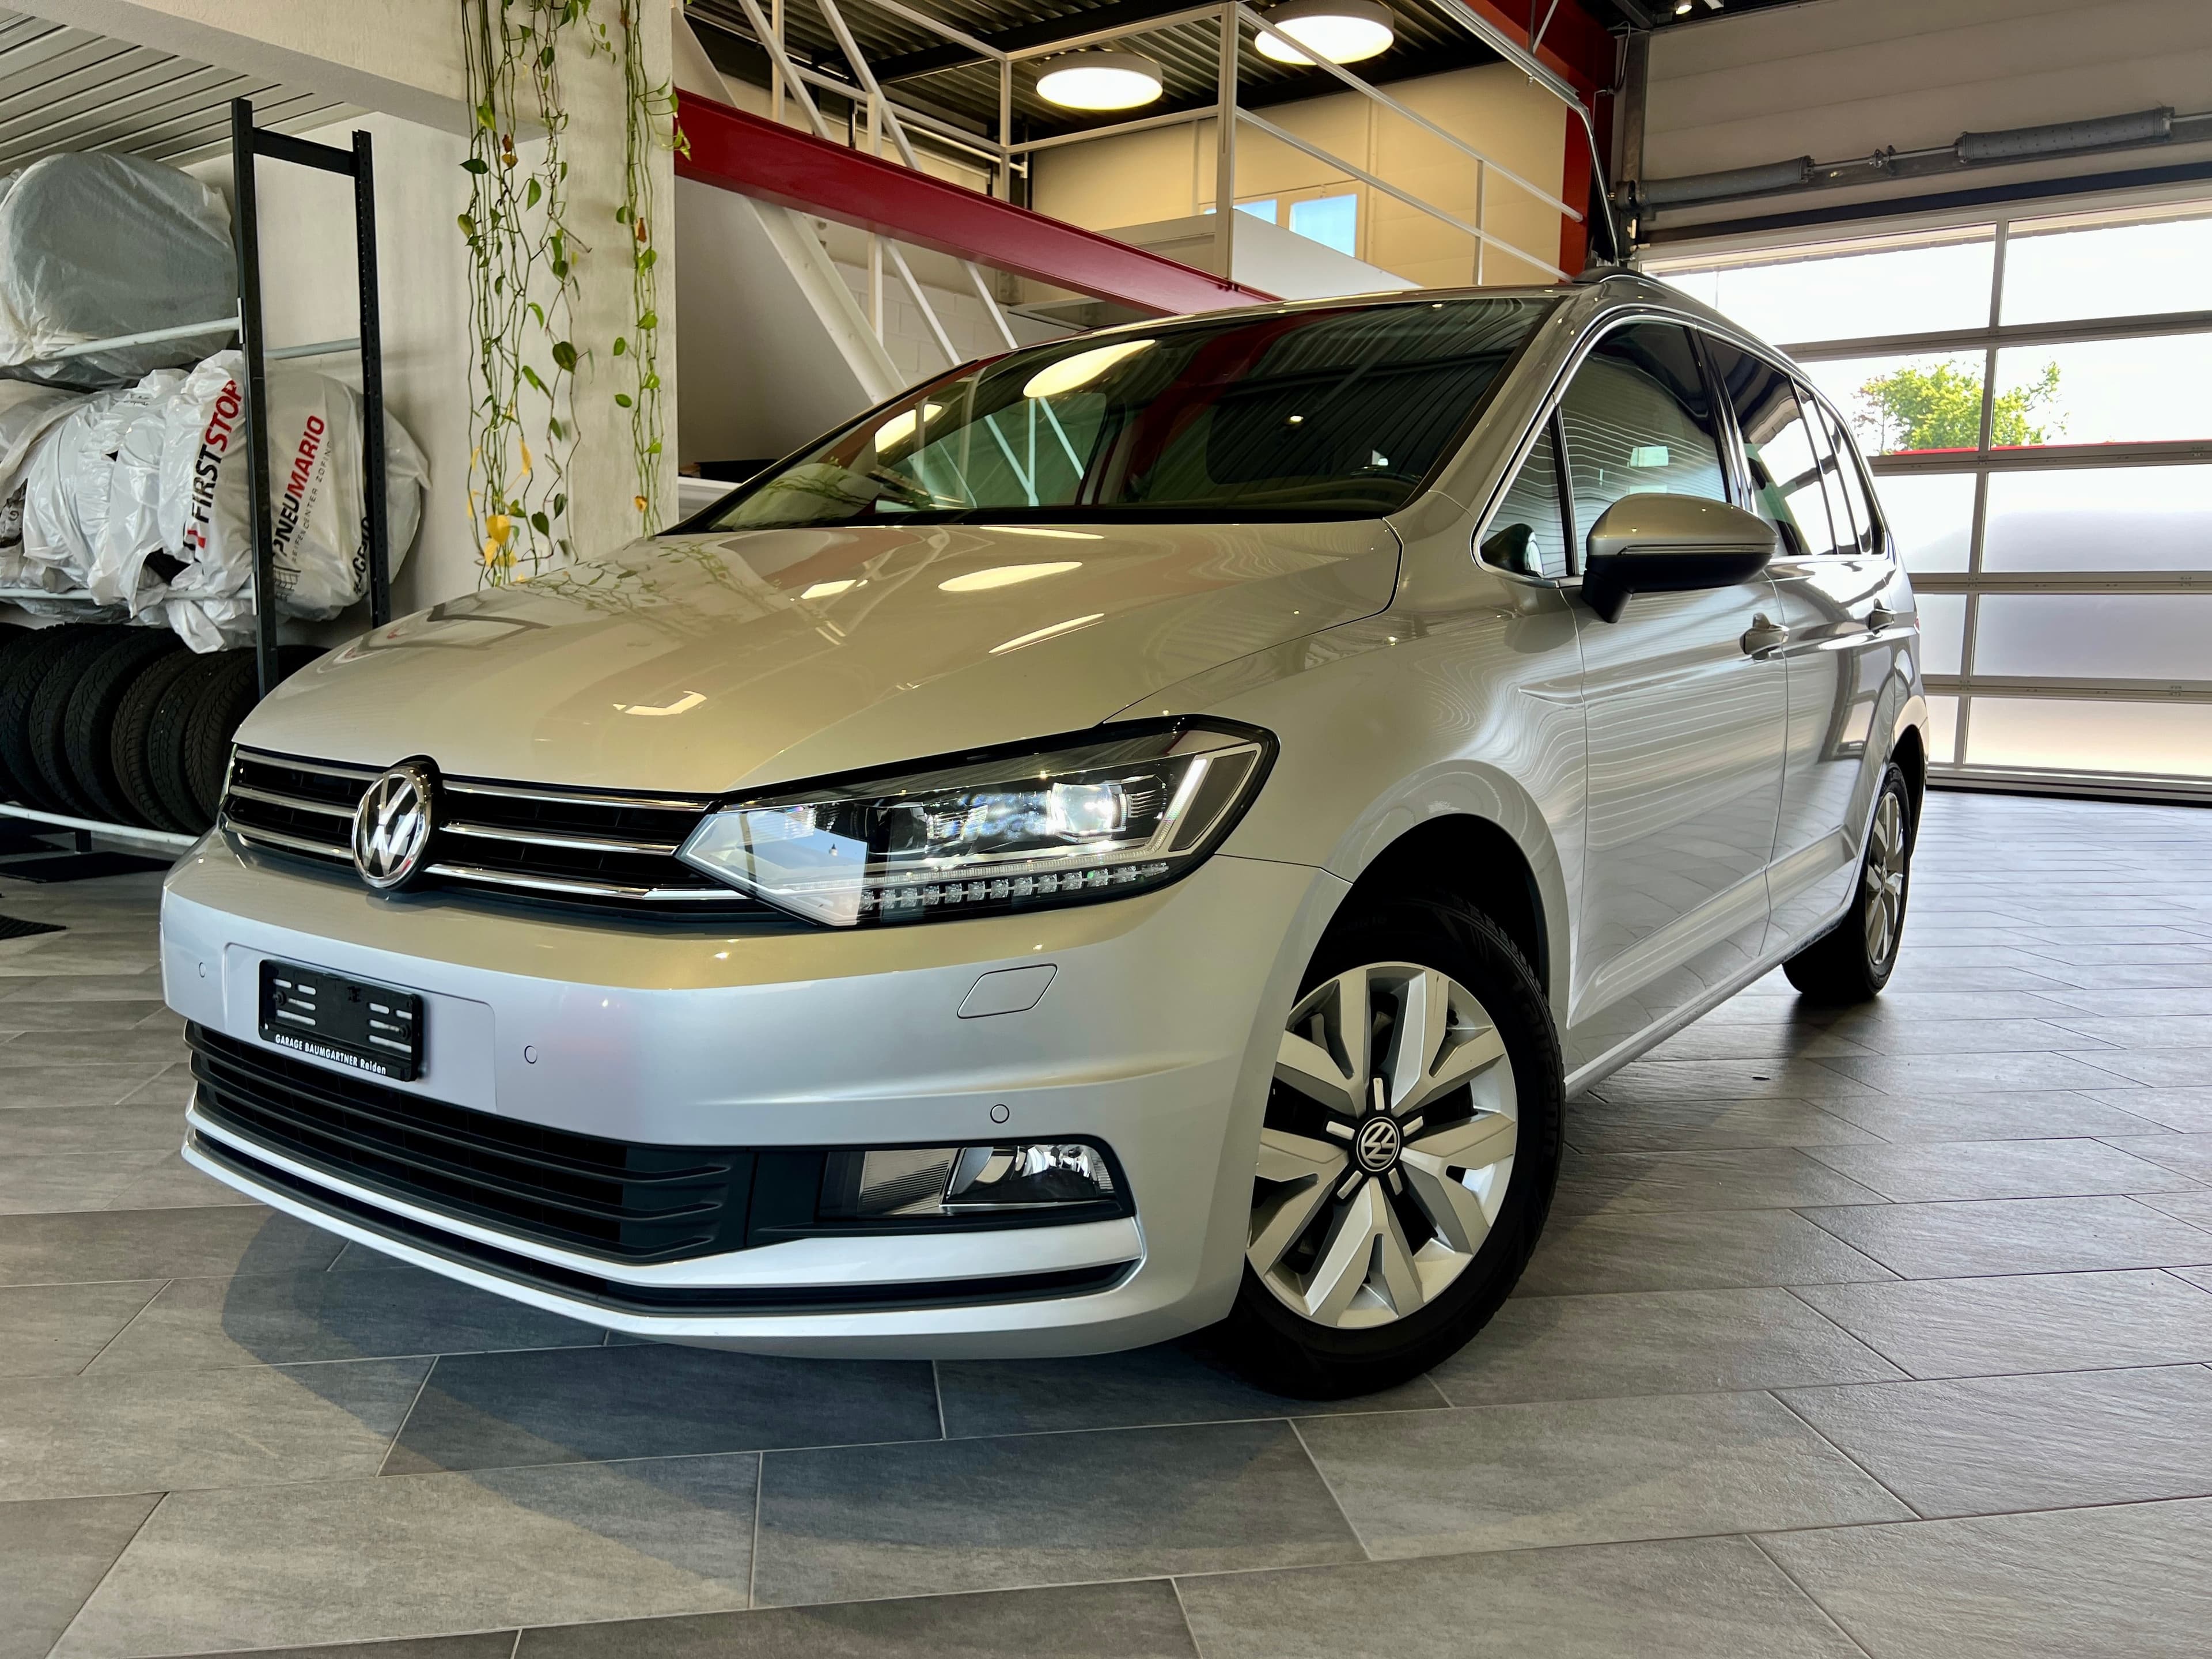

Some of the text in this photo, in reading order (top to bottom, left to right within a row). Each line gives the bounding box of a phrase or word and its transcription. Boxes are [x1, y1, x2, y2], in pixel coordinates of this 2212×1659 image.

[273, 414, 325, 557] PNEUMARIO
[275, 1034, 387, 1075] GARAGE BAUMGARTNER Reiden
